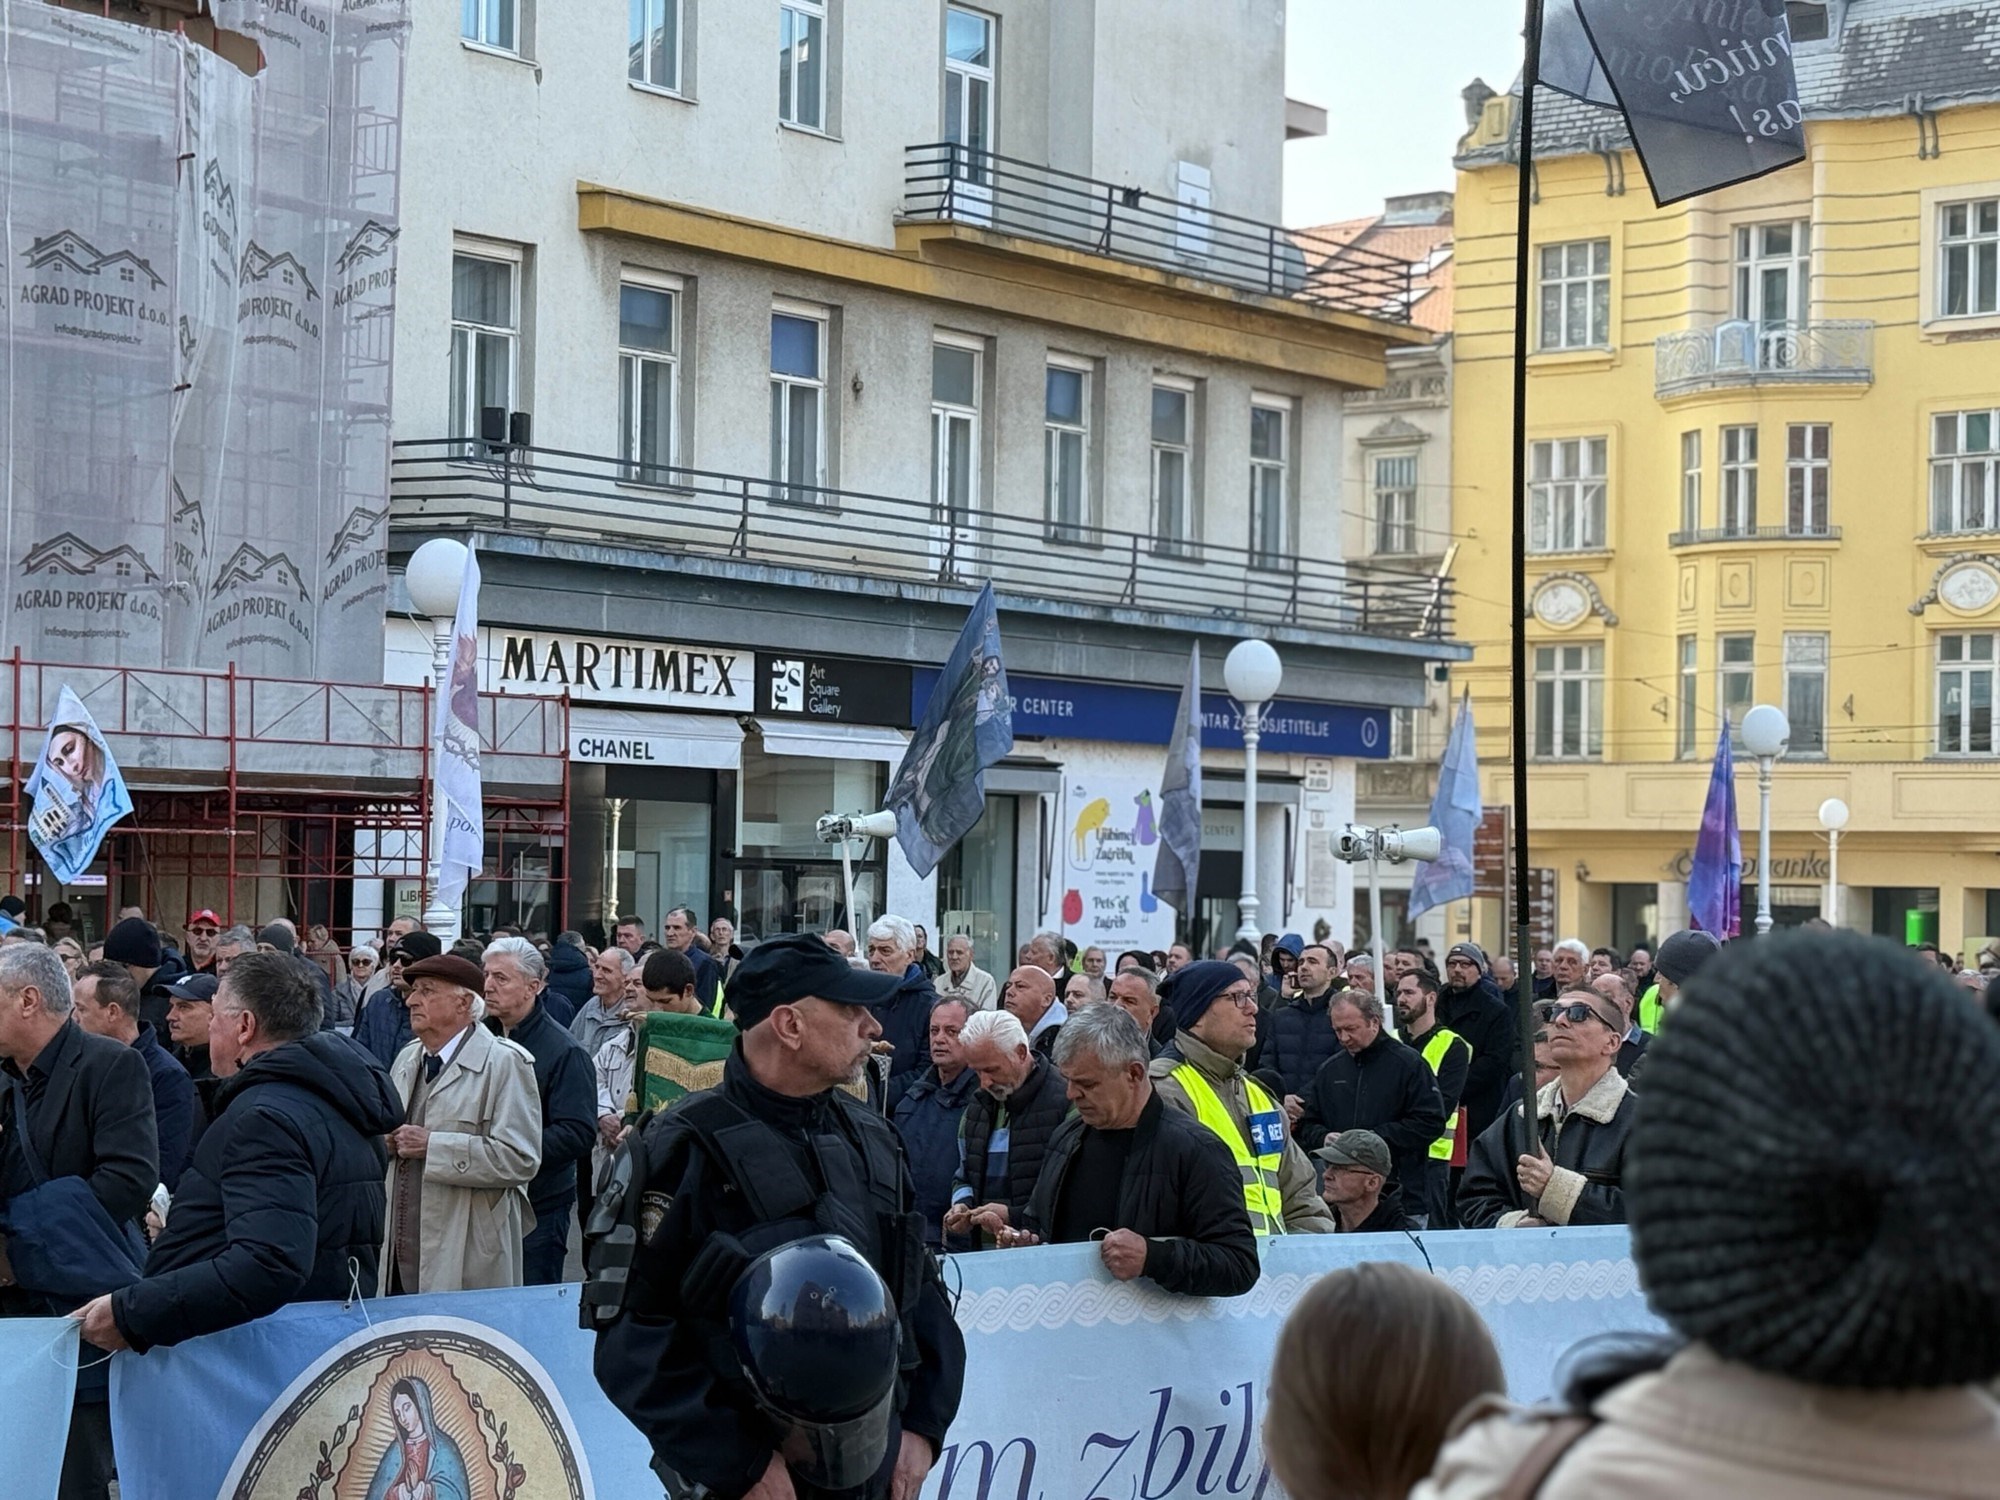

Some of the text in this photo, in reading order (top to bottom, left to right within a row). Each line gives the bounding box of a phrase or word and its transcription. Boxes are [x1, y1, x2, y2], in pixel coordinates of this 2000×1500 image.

[301, 5, 329, 36] d.o.o.
[332, 267, 397, 310] AGRAD PROJE
[20, 285, 69, 305] AGRAD
[74, 289, 135, 317] PROJEKT
[138, 302, 170, 327] d.o.o.
[295, 308, 320, 341] d.o.o.
[322, 549, 387, 607] AGRAD PROJE
[14, 590, 161, 621] AGRAD PROJEKT d.o.o.
[205, 597, 313, 645] AGRAD PROJEKT d.o.o.
[499, 635, 737, 698] MARTIMEX
[809, 663, 826, 680] Art
[808, 679, 841, 699] Square
[808, 697, 842, 719] Gallery
[1022, 697, 1074, 718] CENTER
[1200, 712, 1230, 731] NTAR
[1259, 716, 1330, 738] OSJETITELJE
[578, 738, 656, 760] CHANEL
[1203, 825, 1236, 837] CENTER
[936, 1436, 1044, 1500] m
